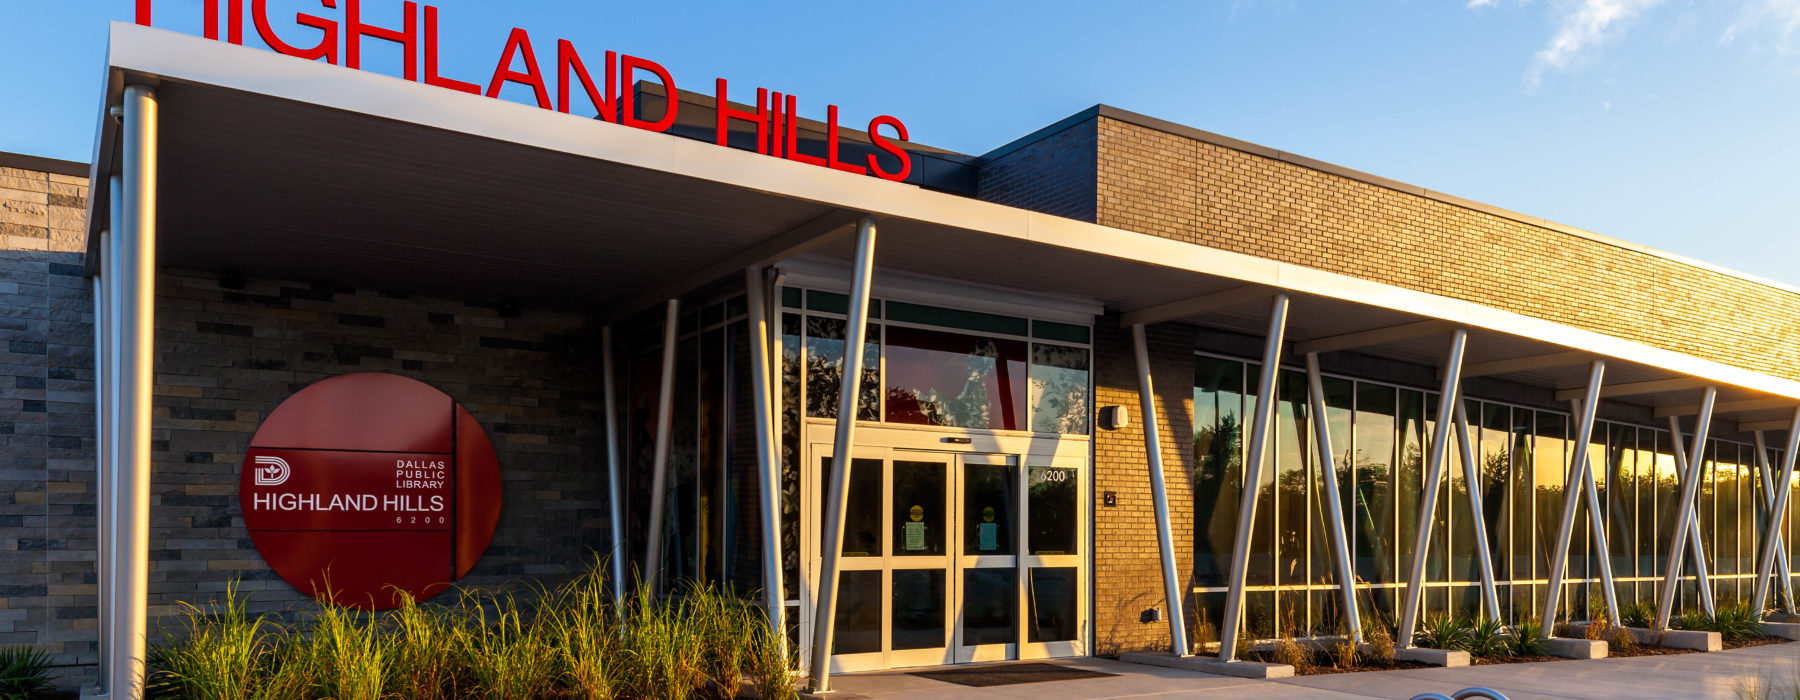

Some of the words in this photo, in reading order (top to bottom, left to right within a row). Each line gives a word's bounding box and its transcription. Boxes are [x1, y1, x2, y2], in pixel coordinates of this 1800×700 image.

[717, 78, 912, 182] HILLS
[396, 459, 445, 469] DALLAS
[396, 470, 445, 479] PUBLIC
[1041, 470, 1065, 482] 6200
[396, 480, 445, 489] LIBRARY
[253, 492, 378, 511] HIGHLAND
[383, 494, 444, 512] HILLS
